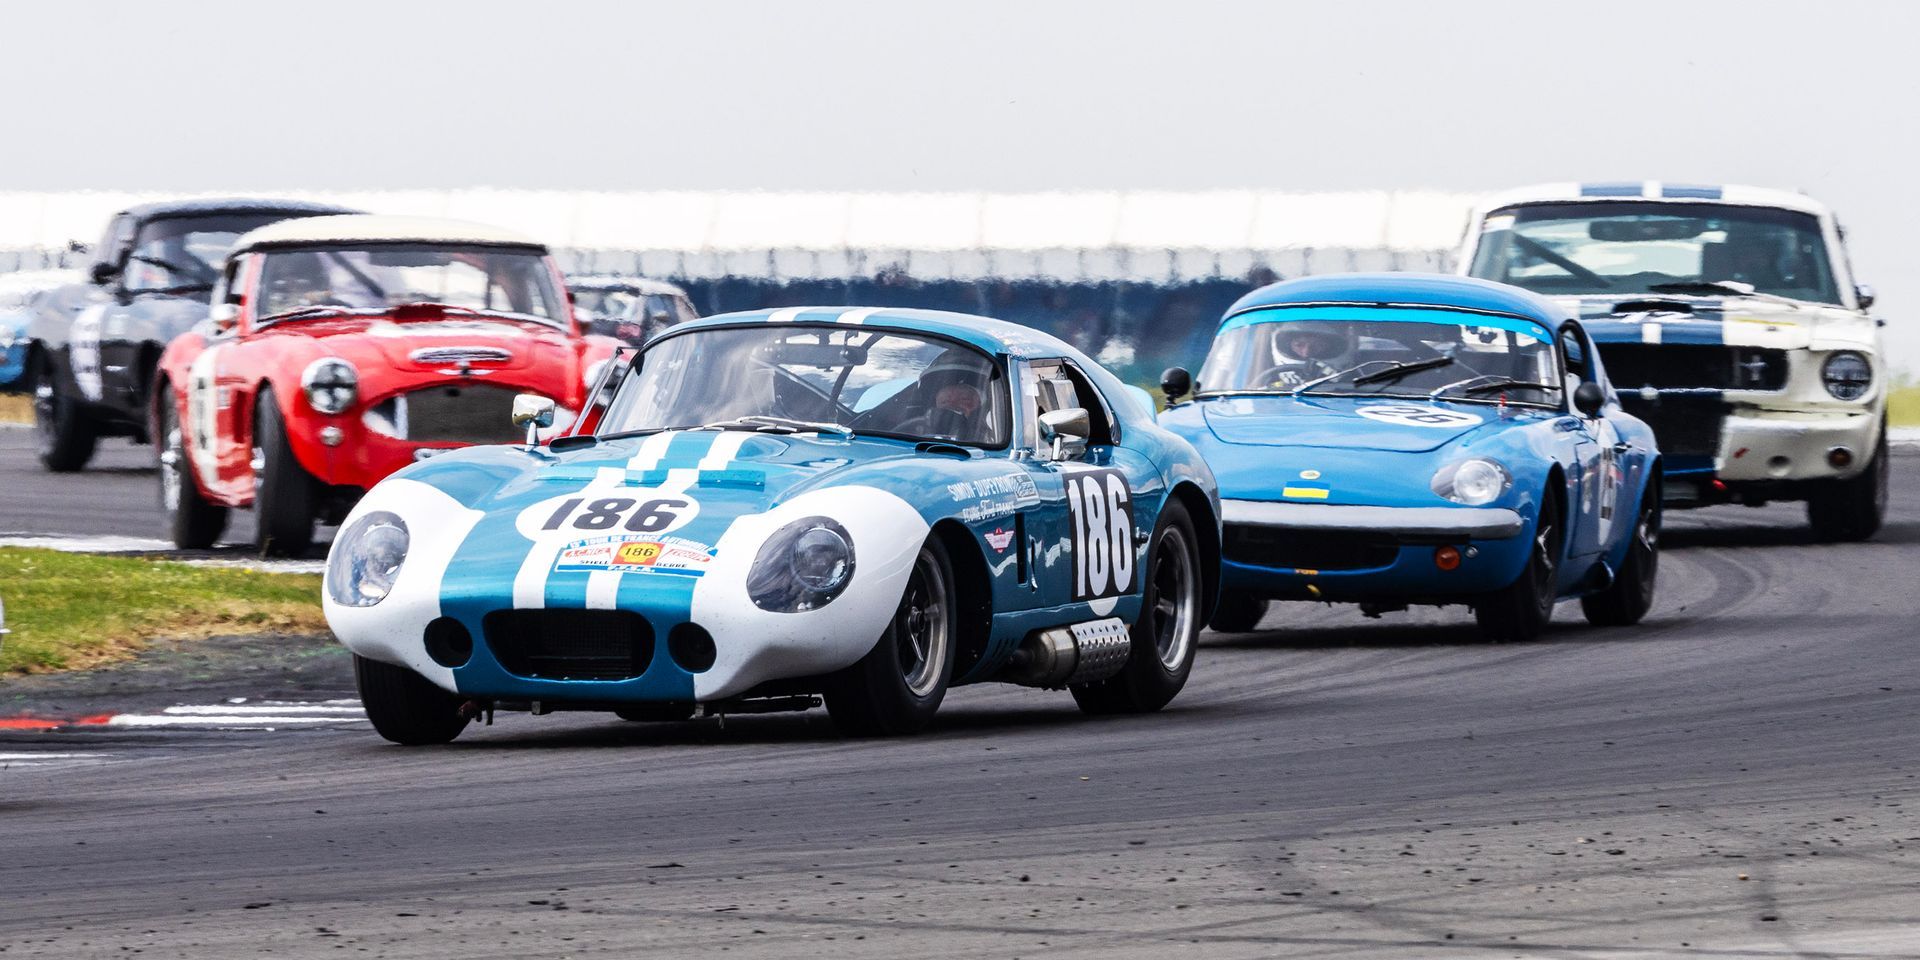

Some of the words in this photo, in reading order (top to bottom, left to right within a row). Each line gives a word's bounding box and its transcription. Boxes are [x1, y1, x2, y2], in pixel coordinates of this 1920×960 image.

[1365, 407, 1468, 423] 26
[541, 498, 688, 532] 186
[584, 537, 609, 546] TOUR
[610, 535, 624, 543] DE
[624, 534, 661, 543] FRANCE
[1068, 473, 1133, 597] 186
[624, 547, 655, 557] 186
